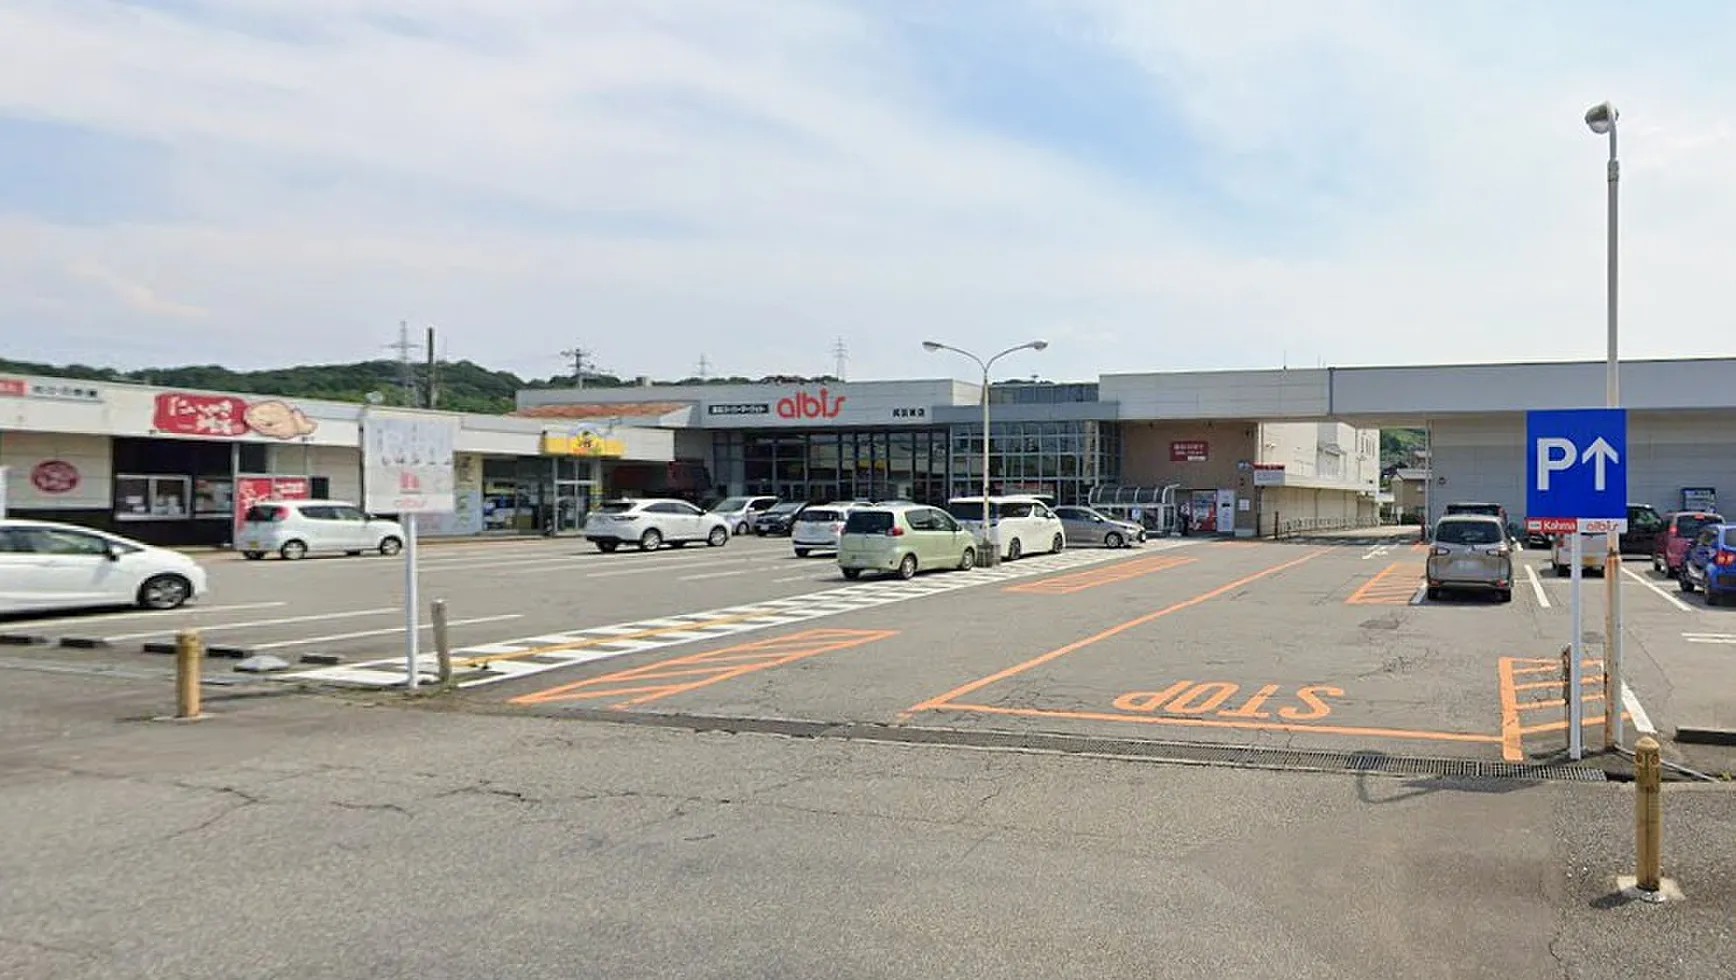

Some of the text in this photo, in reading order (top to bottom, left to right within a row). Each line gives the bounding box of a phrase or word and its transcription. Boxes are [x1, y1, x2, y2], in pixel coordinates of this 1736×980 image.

[777, 388, 846, 419] albis
[1537, 437, 1577, 491] P
[1586, 520, 1618, 532] albis
[1113, 680, 1344, 720] STOP
